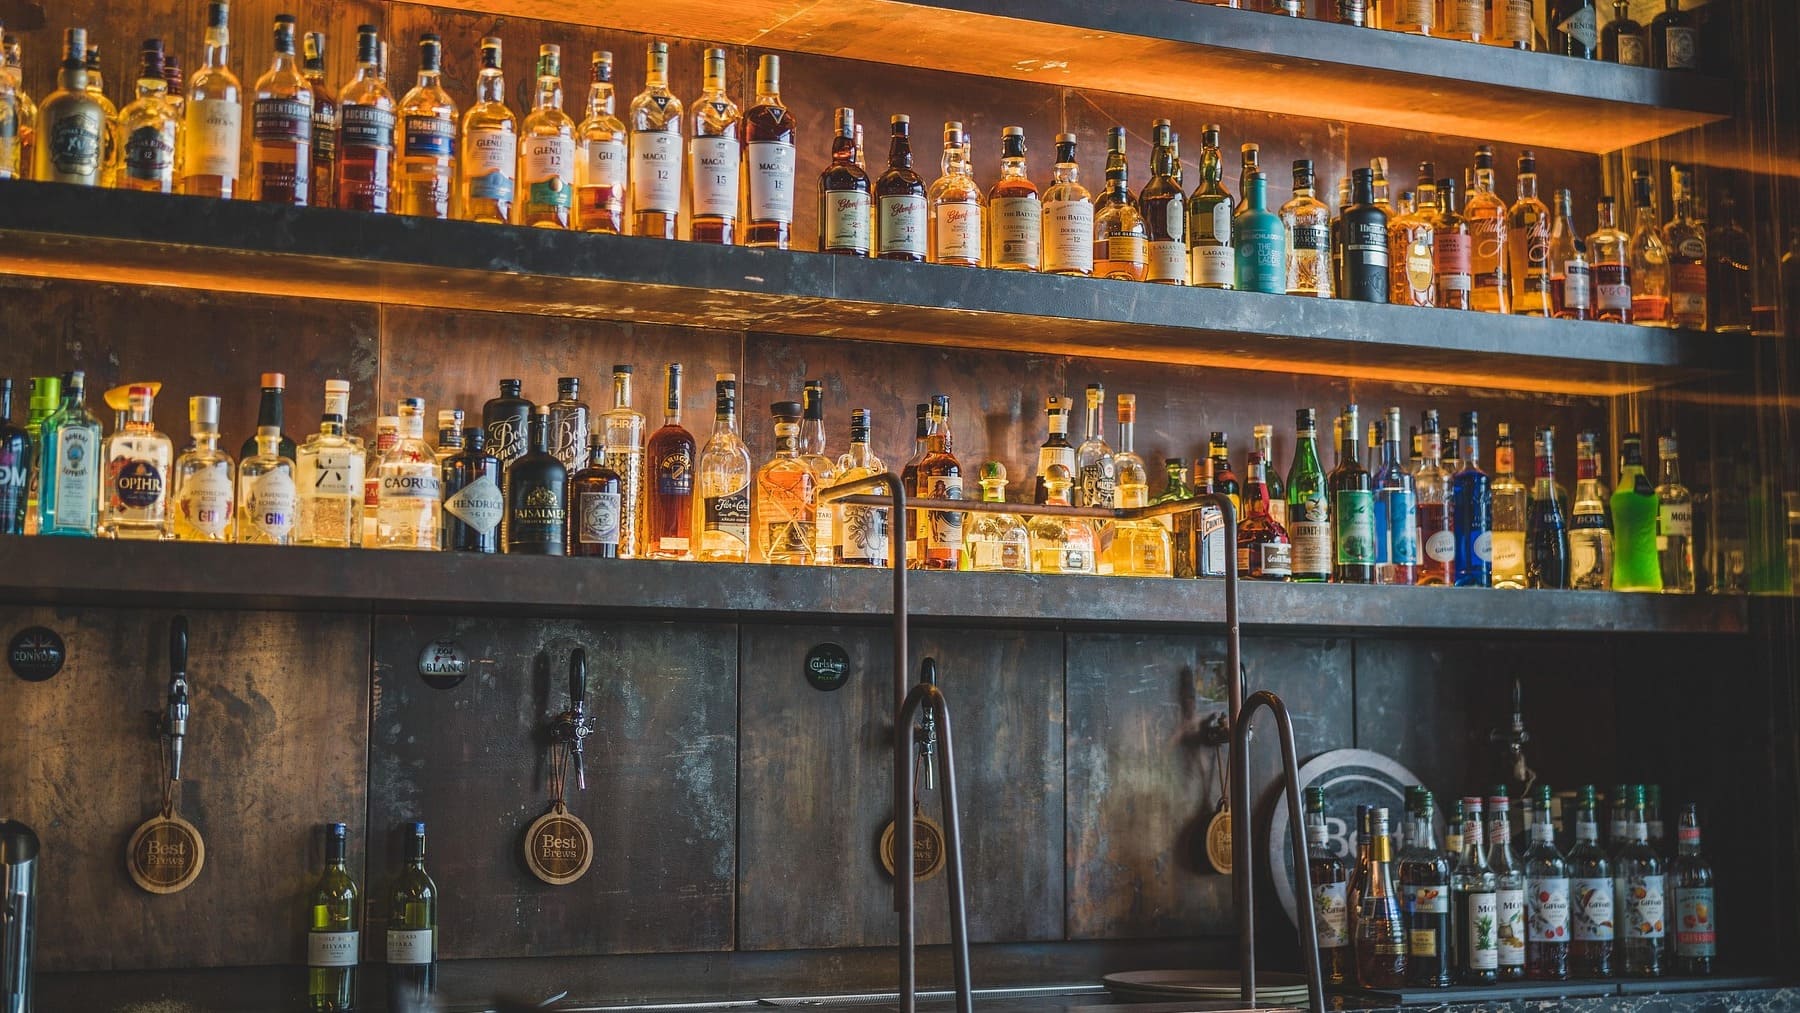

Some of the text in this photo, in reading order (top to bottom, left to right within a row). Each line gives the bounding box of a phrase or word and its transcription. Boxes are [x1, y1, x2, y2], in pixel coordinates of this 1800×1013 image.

[551, 157, 561, 165] 12
[658, 170, 668, 179] 12
[717, 176, 727, 184] 15
[663, 454, 693, 471] BRUGAL
[119, 478, 161, 490] OPIHR
[198, 511, 219, 521] GIN
[266, 513, 284, 525] GIN
[426, 662, 465, 672] BLANC
[542, 834, 577, 849] Best
[147, 841, 186, 854] Best
[543, 848, 577, 859] Brews
[147, 854, 185, 865] Brews
